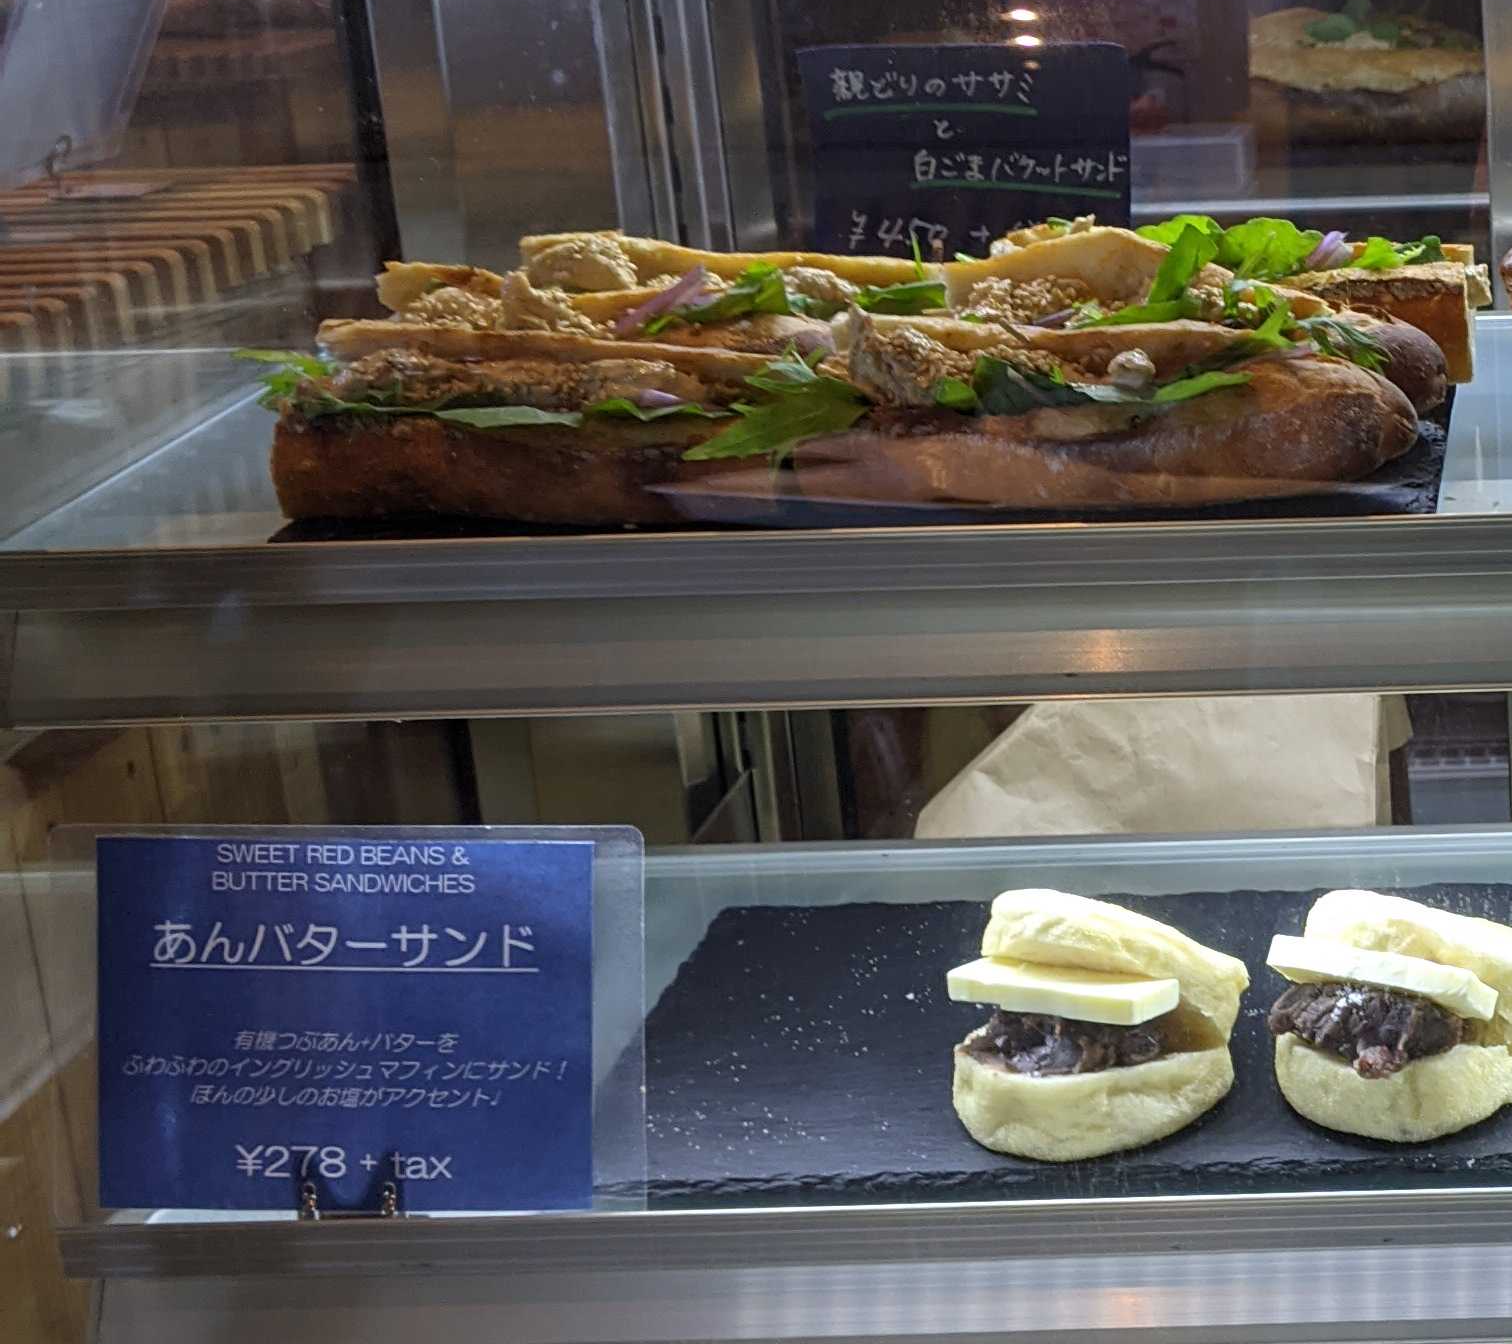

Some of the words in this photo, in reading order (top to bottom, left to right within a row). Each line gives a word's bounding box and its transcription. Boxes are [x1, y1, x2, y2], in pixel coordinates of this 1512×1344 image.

[217, 844, 300, 865] SWEET
[307, 845, 354, 865] RED
[361, 846, 445, 866] BEANS
[452, 848, 470, 865] &
[212, 872, 308, 892] BUTTER
[314, 873, 475, 894] SANDWICHES
[152, 920, 535, 967] あんバターサンド
[235, 1146, 346, 1180] ¥278
[359, 1154, 376, 1171] +
[393, 1152, 452, 1179] tax
